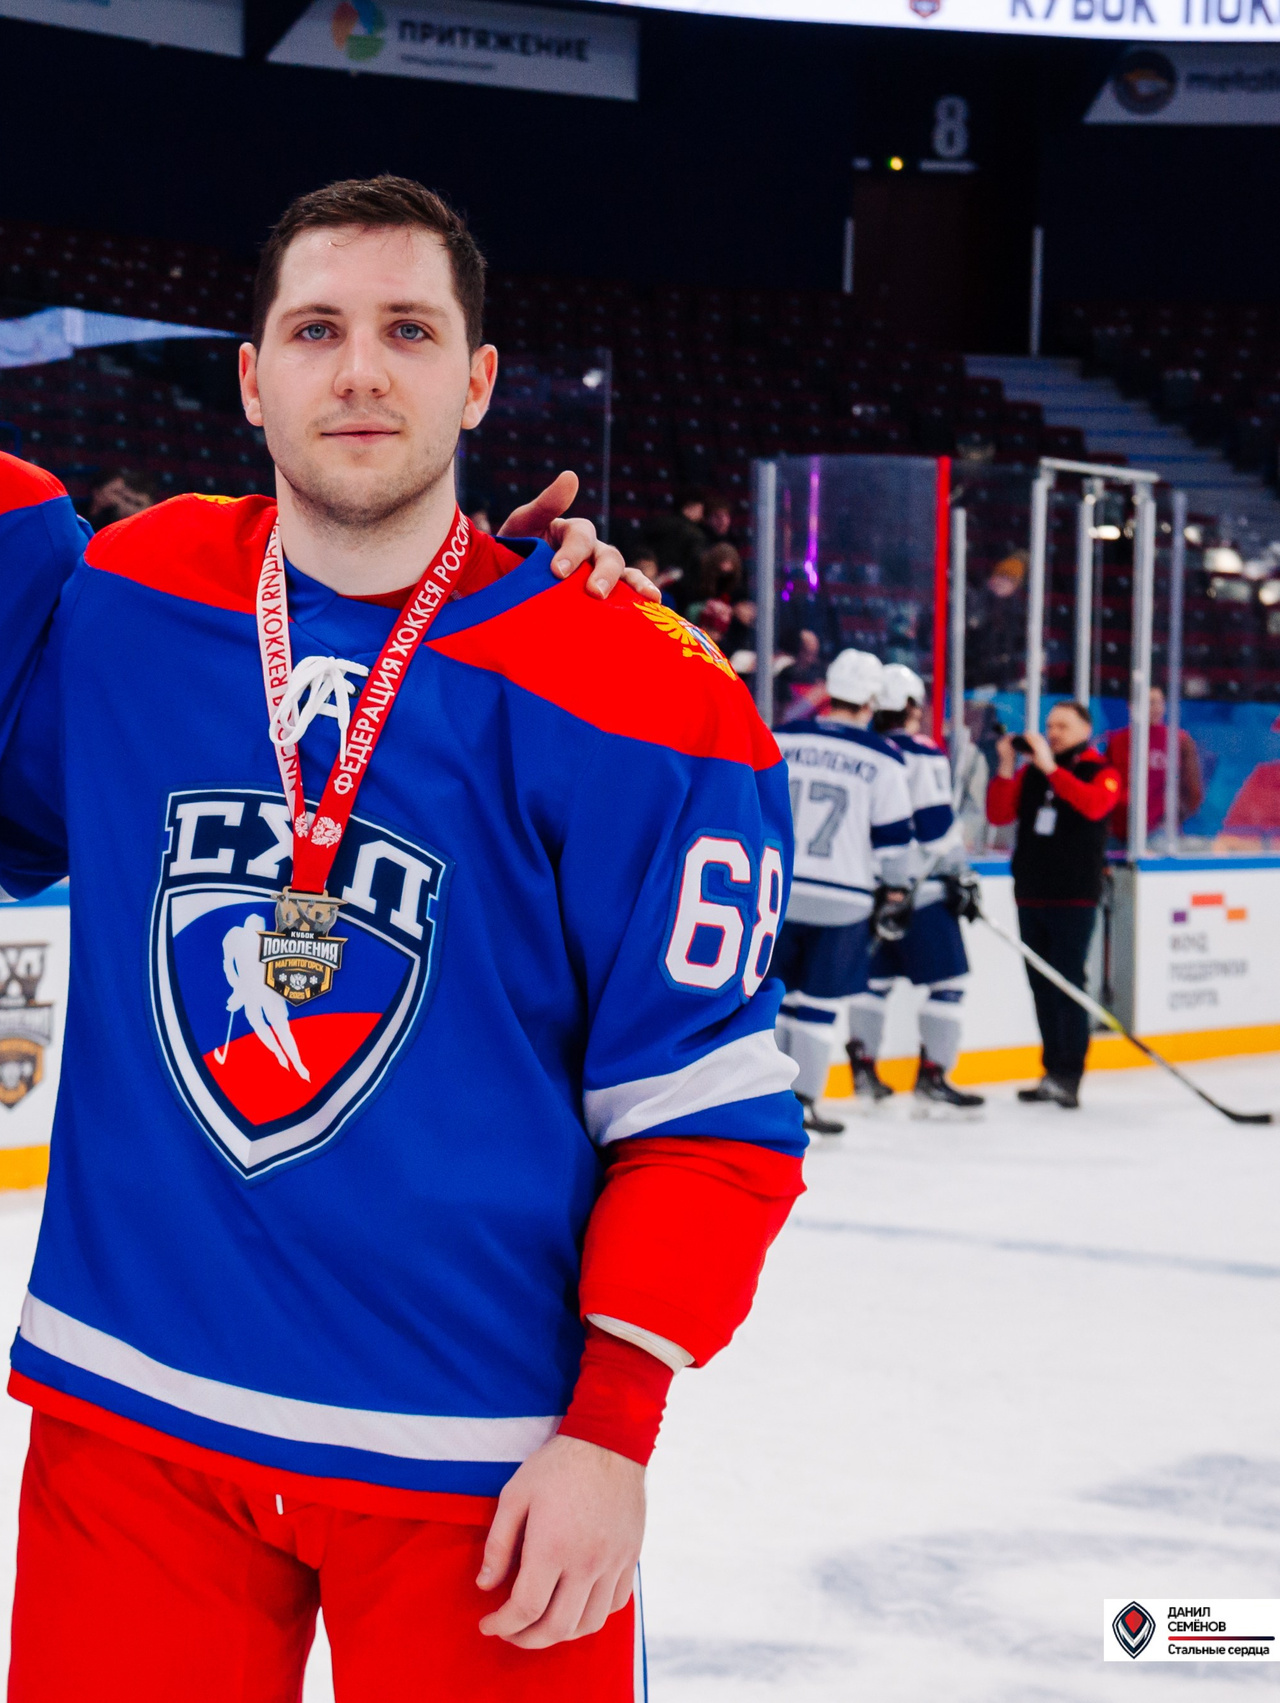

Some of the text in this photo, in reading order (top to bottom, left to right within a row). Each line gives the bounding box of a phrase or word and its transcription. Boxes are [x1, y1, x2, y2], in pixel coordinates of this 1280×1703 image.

[397, 18, 590, 63] ПРИТЯЖЕНИЕ
[933, 95, 968, 158] 8
[333, 657, 404, 795] ФЕДЕРАЦИЯ
[388, 579, 445, 657] ХОККЕЯ
[290, 931, 315, 940] КУБОК
[664, 835, 784, 998] 68
[263, 937, 339, 963] ПОКОЛЕНИЯ
